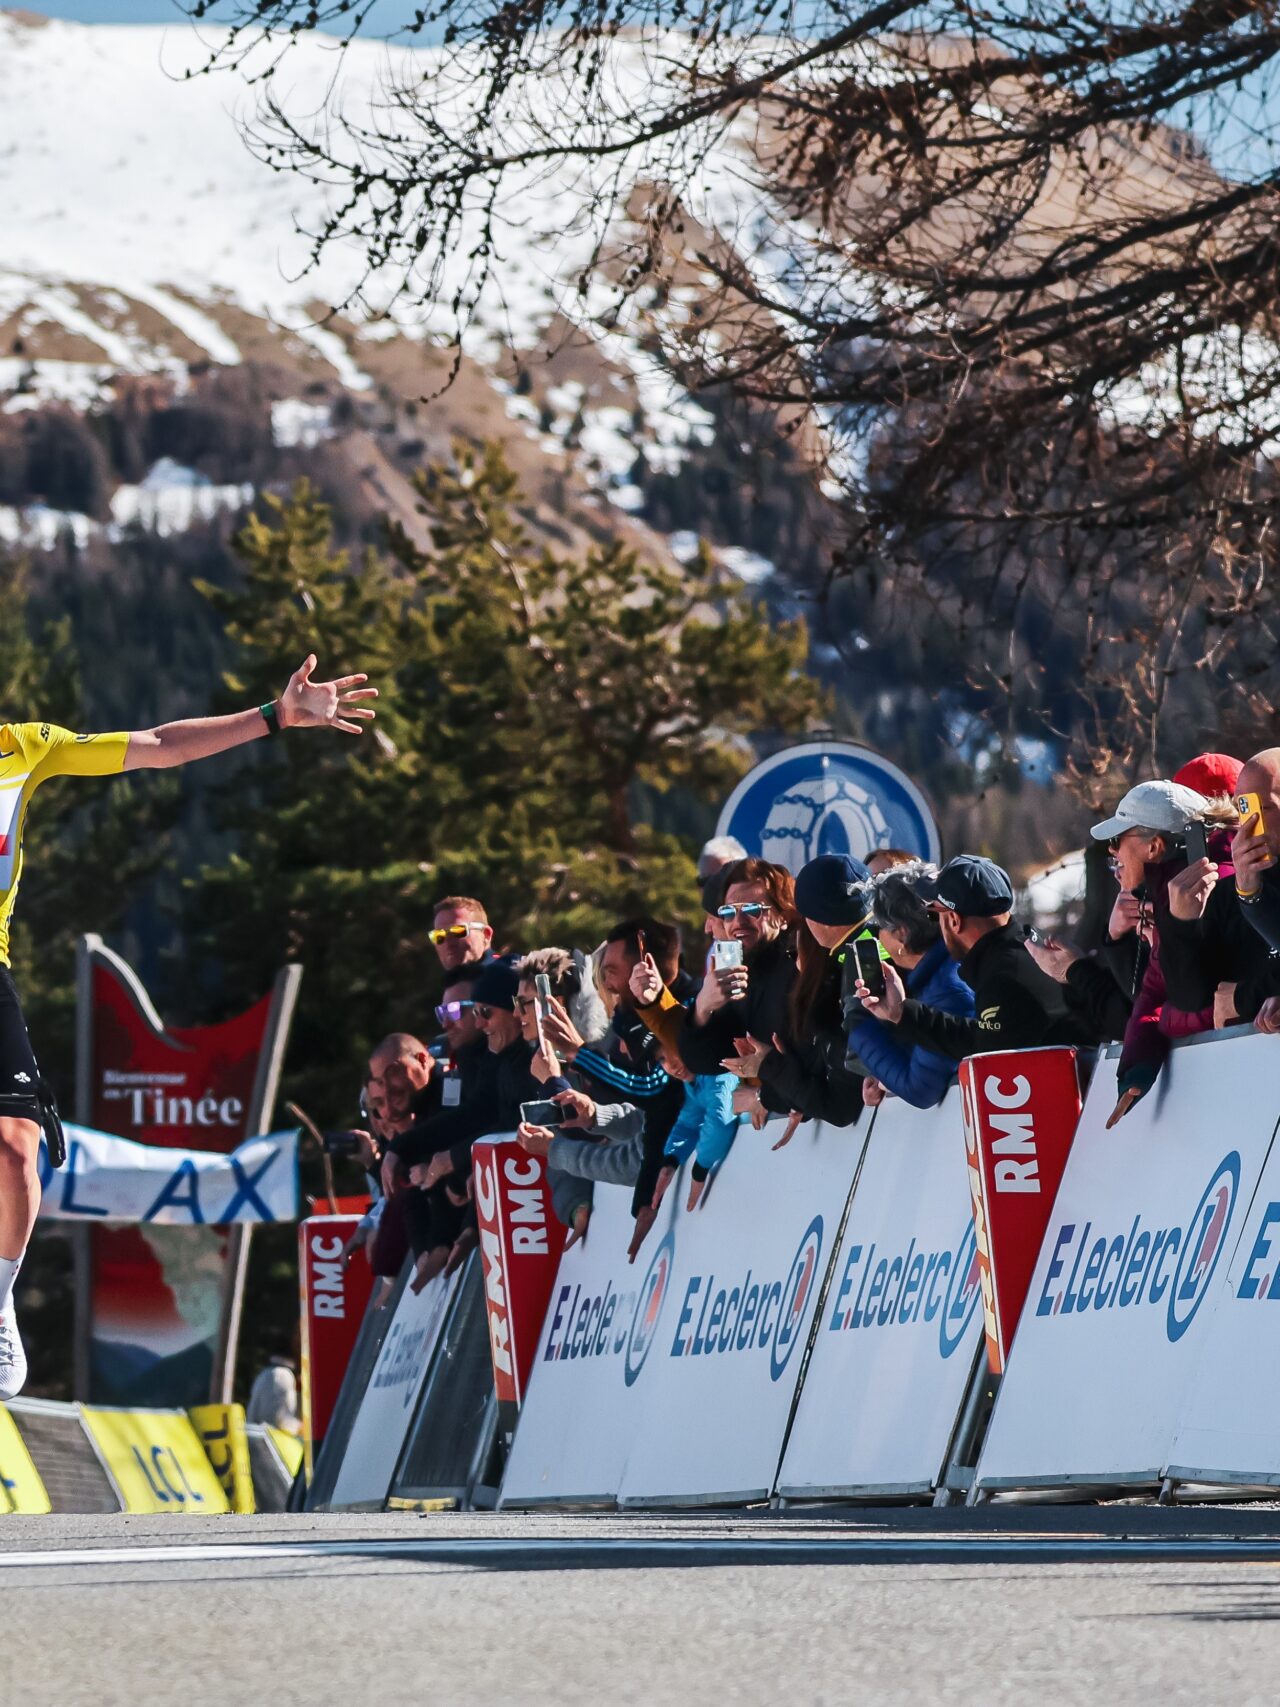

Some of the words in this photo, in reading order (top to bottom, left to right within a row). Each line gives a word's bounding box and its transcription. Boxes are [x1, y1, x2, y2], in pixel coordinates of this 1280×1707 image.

[125, 1088, 243, 1126] Tinée
[984, 1074, 1042, 1194] RMC
[504, 1157, 549, 1255] RMC
[312, 1234, 346, 1320] RMC
[474, 1159, 513, 1376] RMC
[669, 1269, 783, 1358] E.Leclerc
[828, 1237, 953, 1332] E.Leclerc
[1035, 1214, 1182, 1318] E.Leclerc
[131, 1445, 205, 1503] LCL
